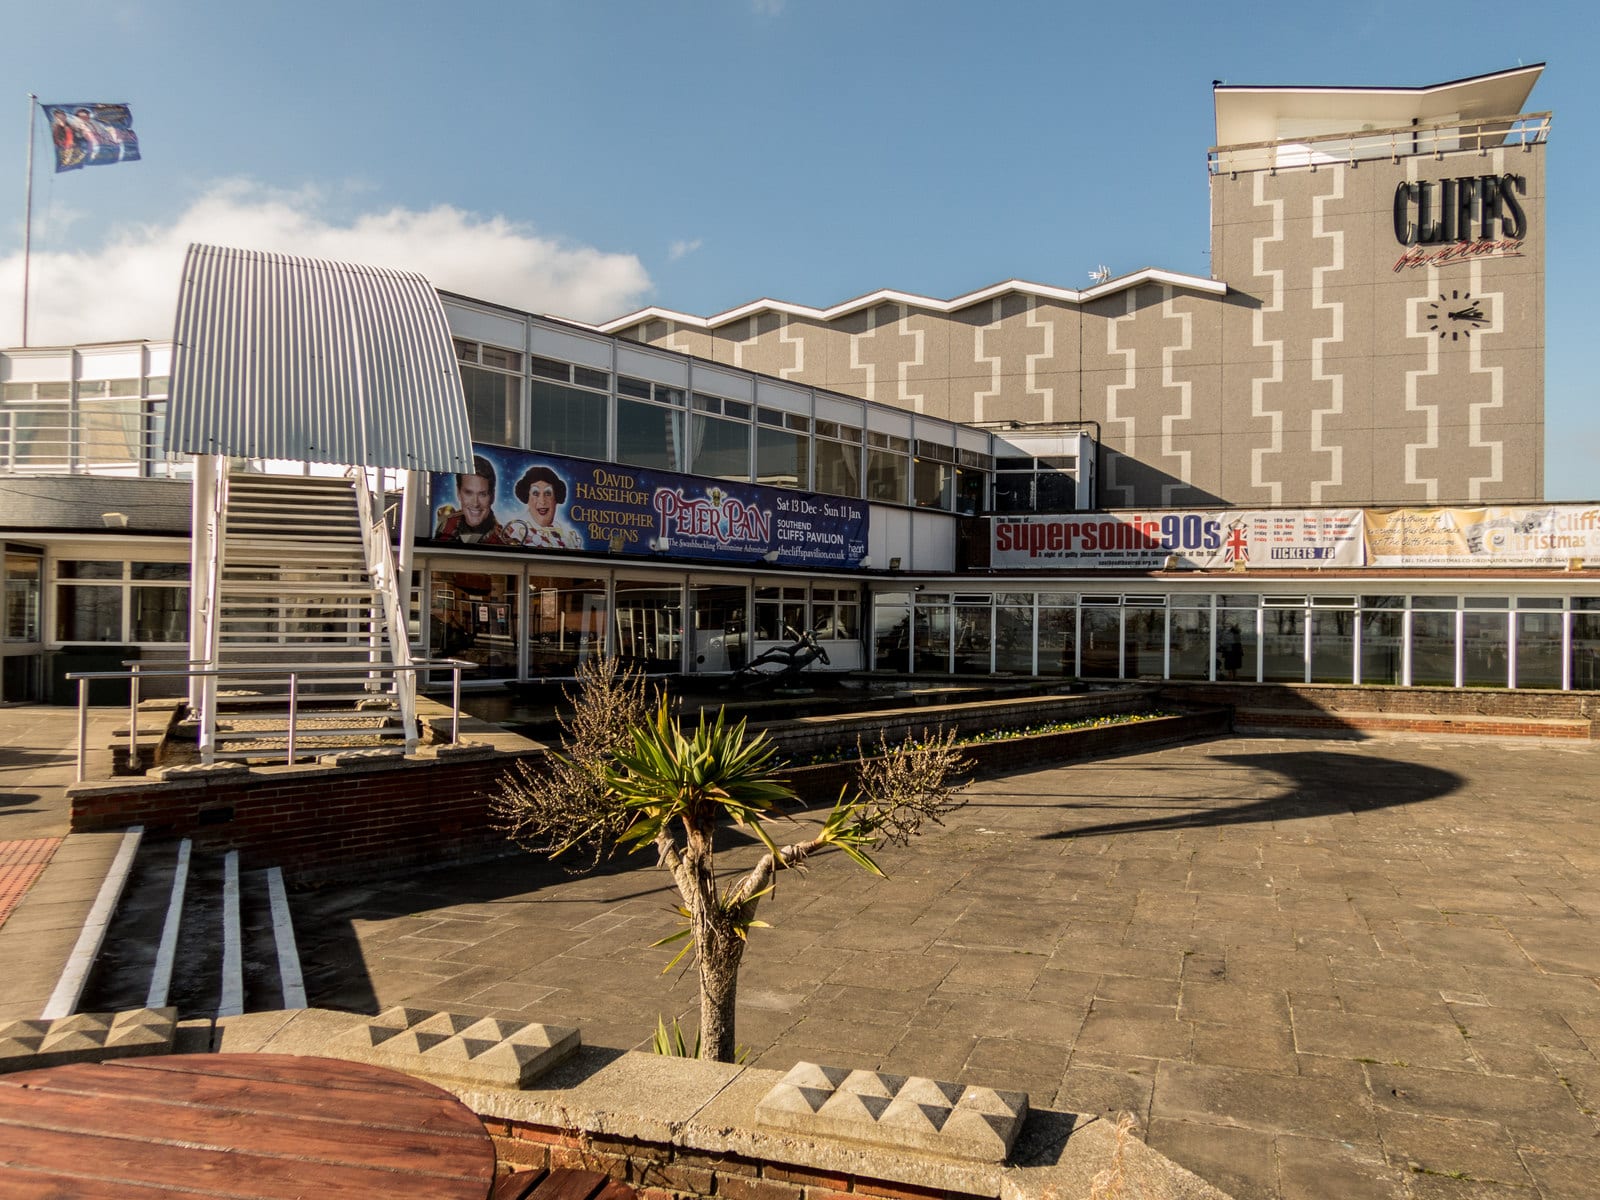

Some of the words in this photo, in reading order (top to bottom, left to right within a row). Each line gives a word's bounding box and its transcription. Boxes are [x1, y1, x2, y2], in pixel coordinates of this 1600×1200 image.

[1393, 172, 1526, 247] CLIFFS
[593, 468, 634, 489] DAVID
[576, 482, 649, 505] HASSELHOFF
[570, 505, 654, 528] CHRISTOPHER
[654, 488, 729, 544] PETER
[723, 499, 771, 543] PAN
[777, 497, 789, 511] Sat
[791, 499, 799, 512] 13
[801, 501, 817, 514] Dec
[824, 503, 838, 517] Sun
[848, 506, 861, 521] Jan
[588, 522, 639, 543] BIGGINS
[777, 519, 812, 530] SOUTHEND
[777, 529, 804, 541] CLIFFS
[806, 531, 844, 545] PAVILION
[1484, 529, 1586, 553] Christmas
[778, 545, 845, 560] thecliffspavilion.co.uk
[848, 543, 865, 553] heart
[1272, 548, 1315, 559] TICKETS
